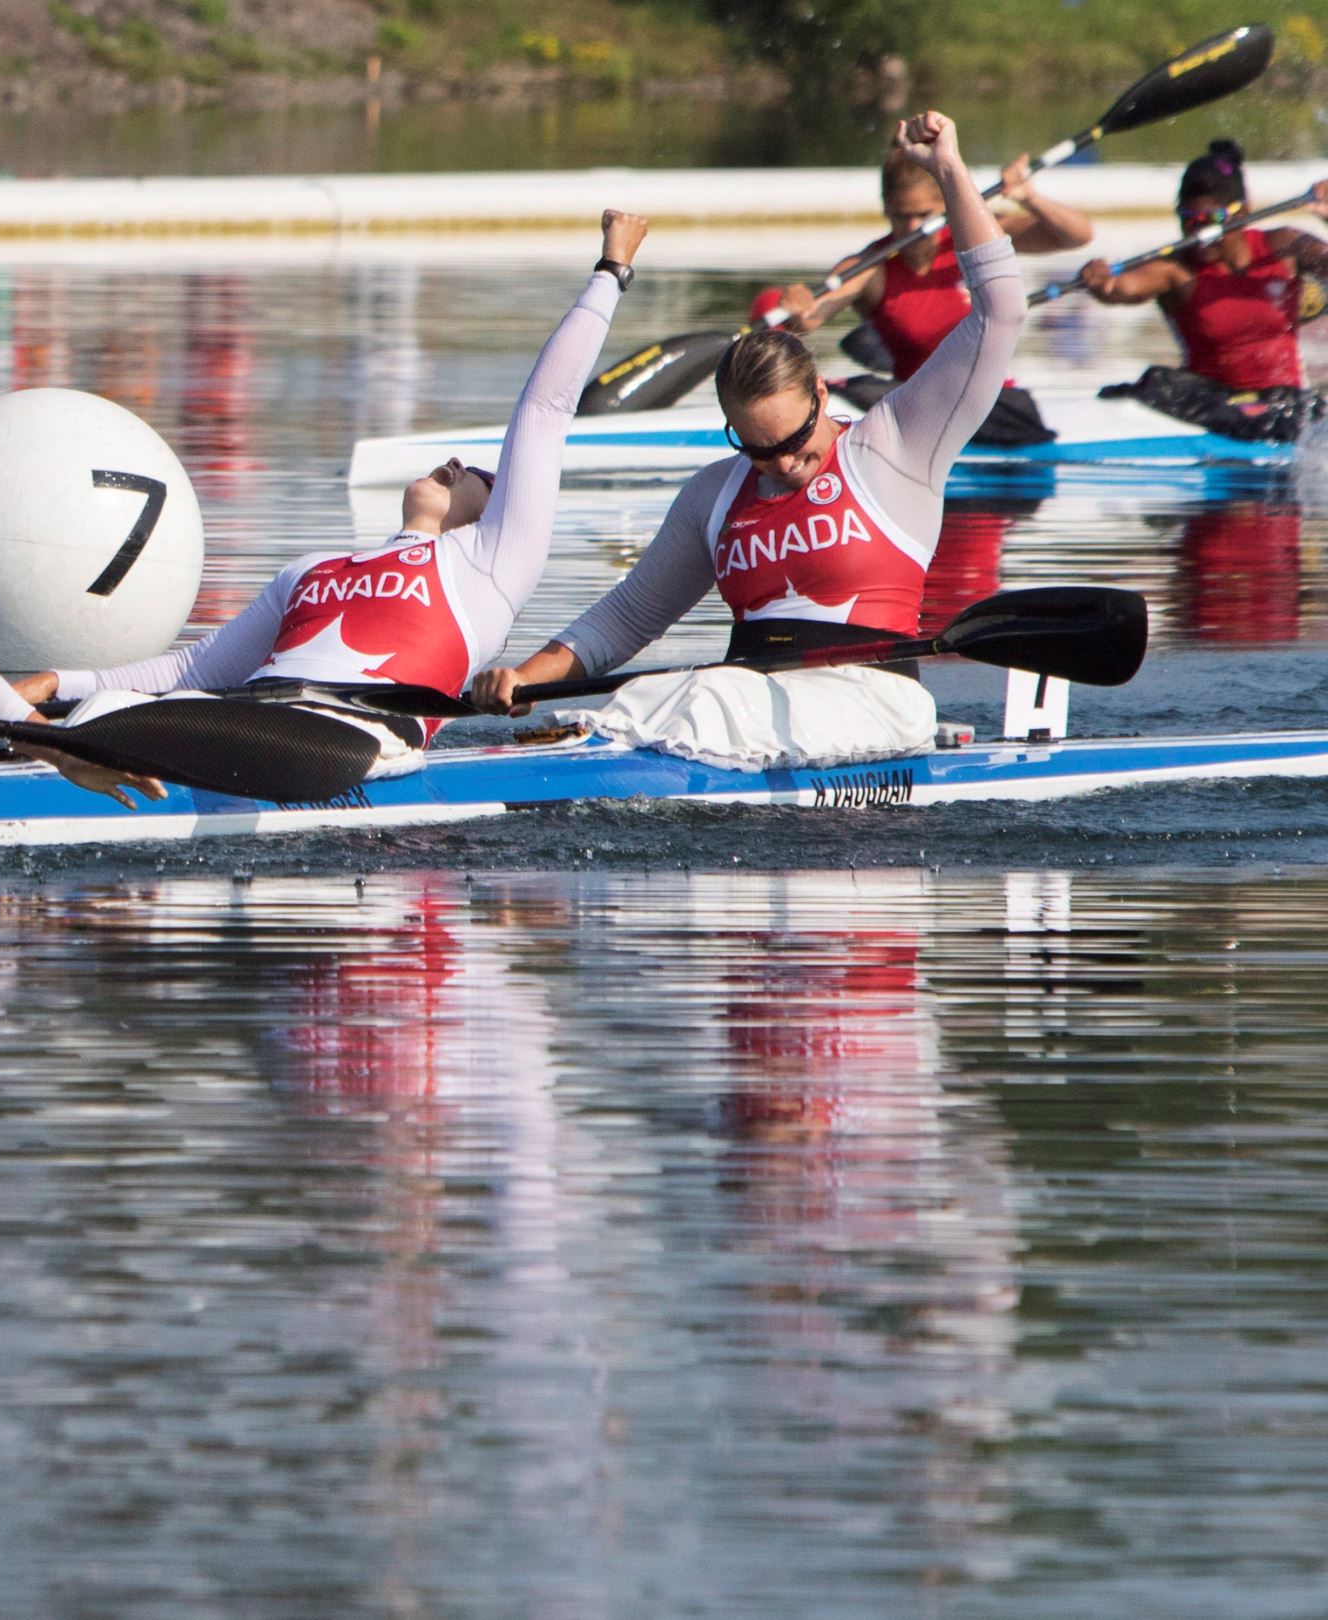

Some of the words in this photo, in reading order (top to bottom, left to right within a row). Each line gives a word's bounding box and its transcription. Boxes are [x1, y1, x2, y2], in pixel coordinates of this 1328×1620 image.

[86, 469, 167, 597] 7
[715, 509, 872, 579] CANADA
[284, 572, 432, 615] CANADA
